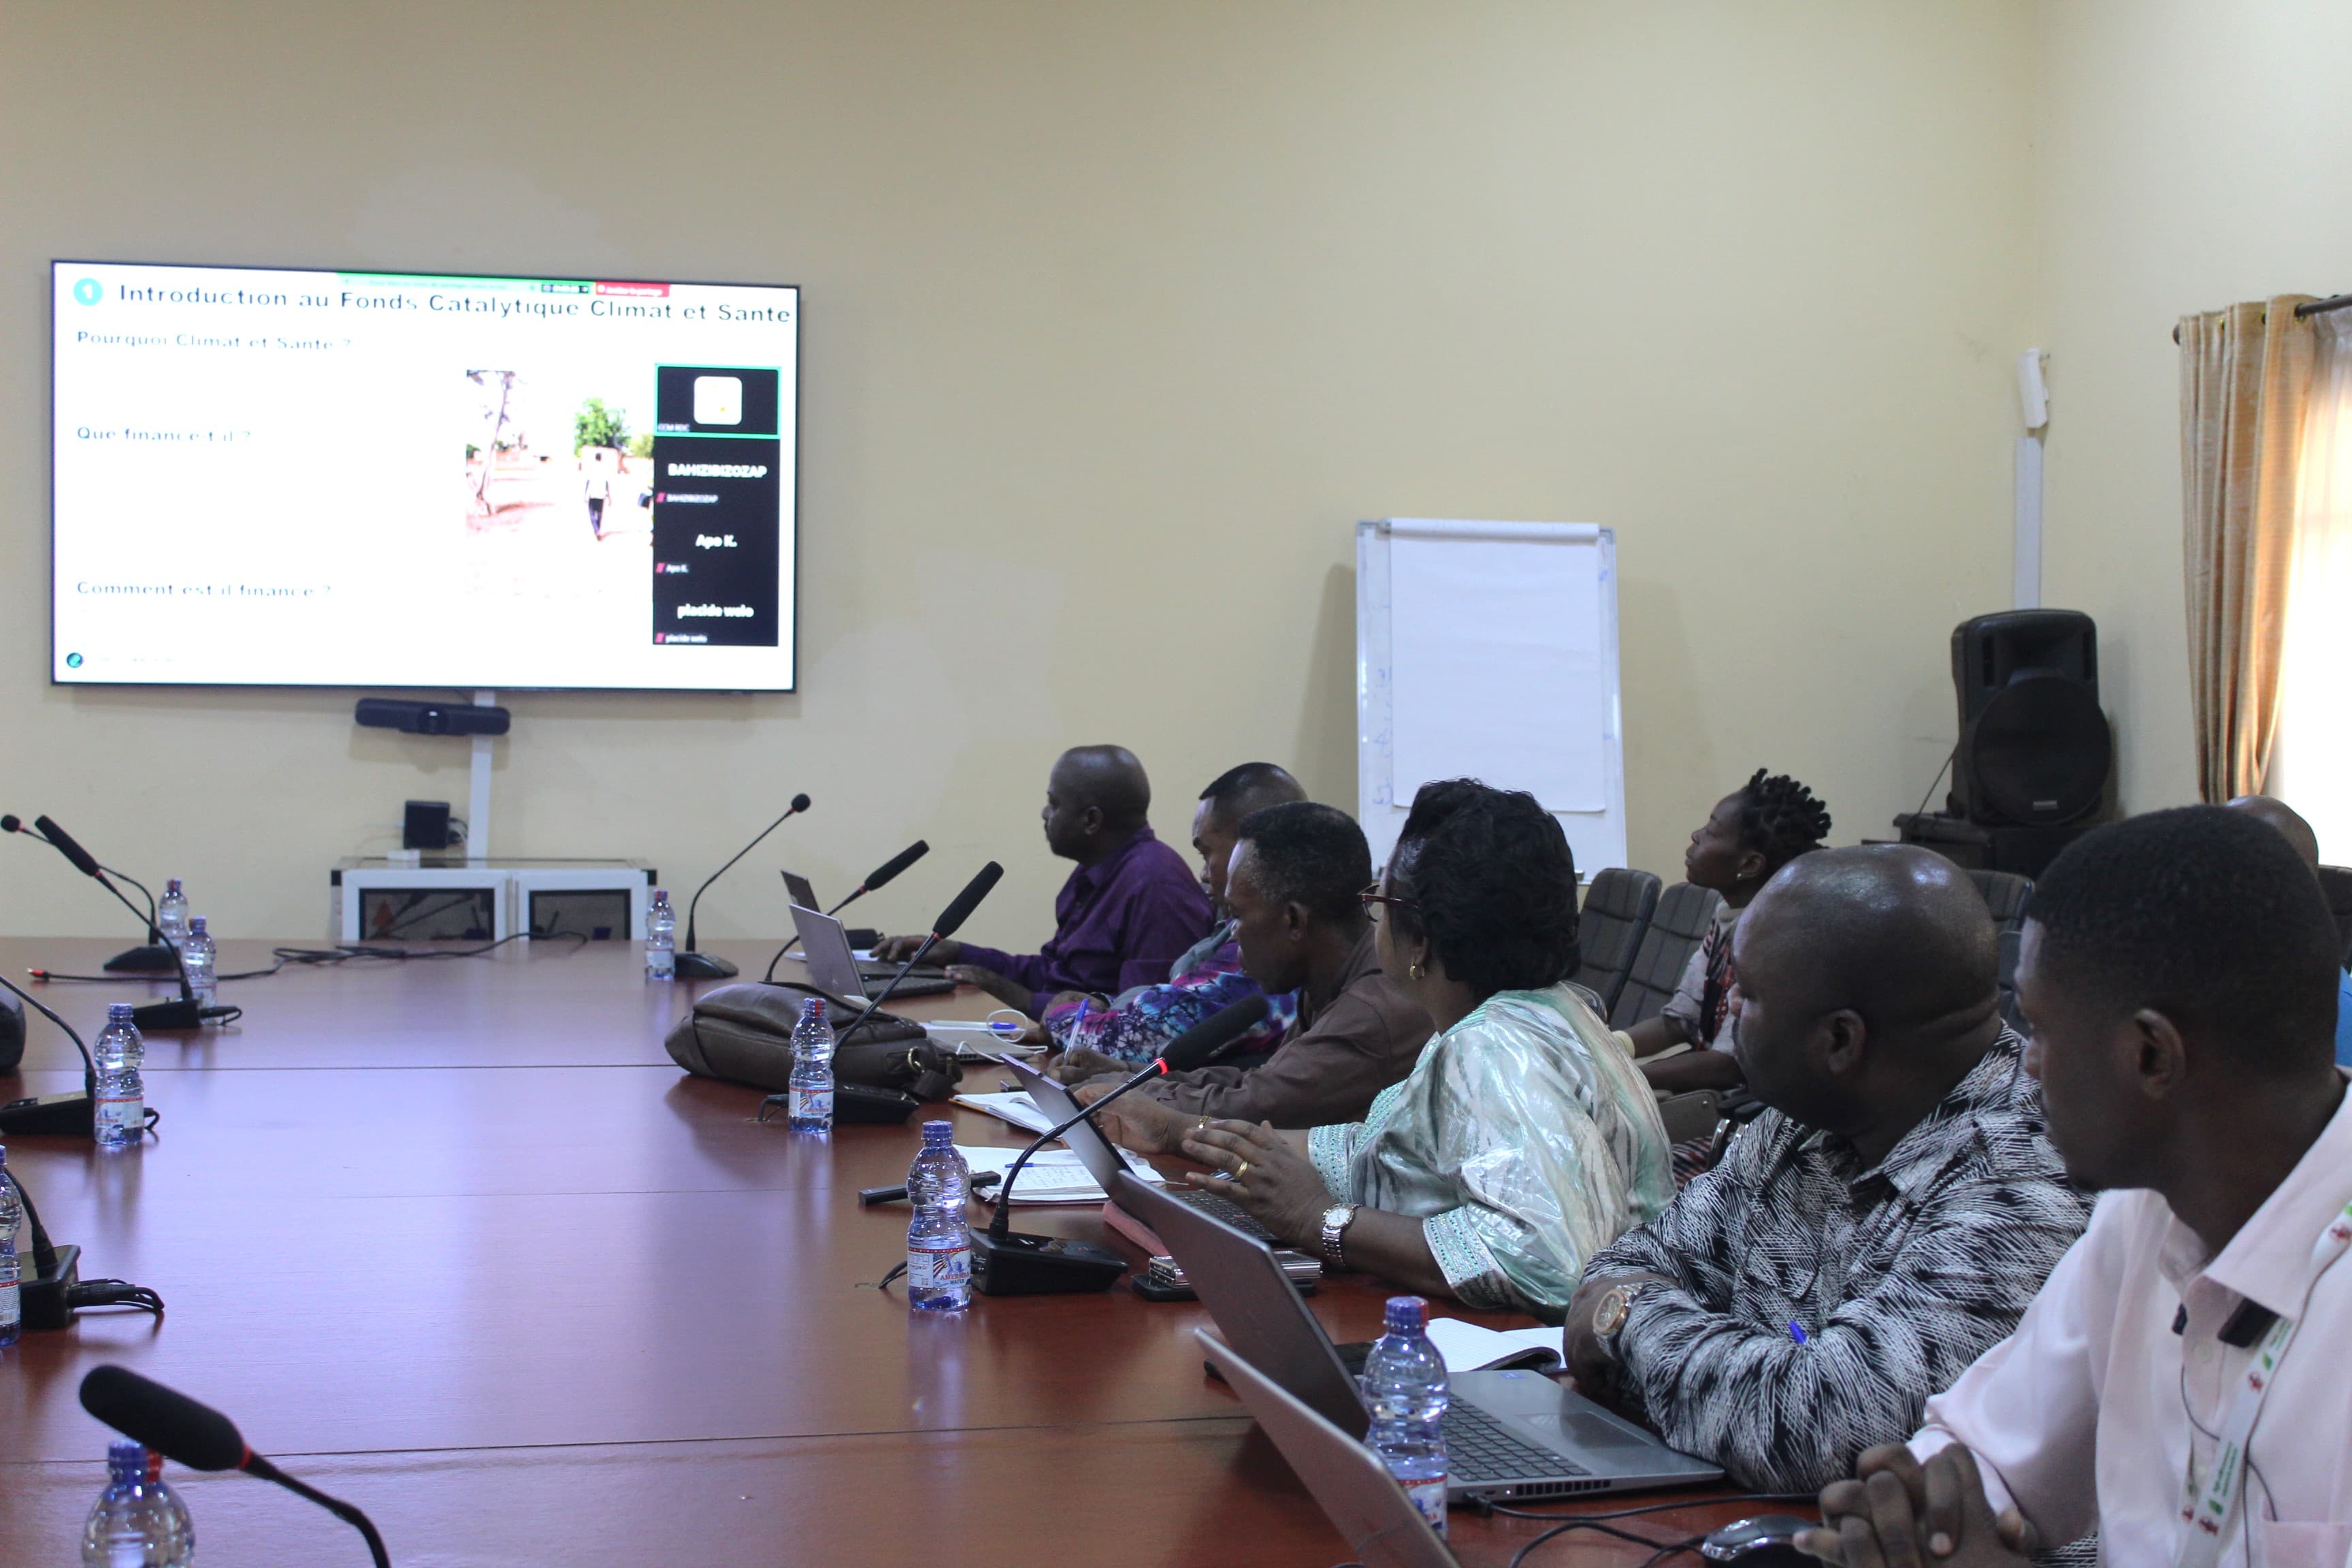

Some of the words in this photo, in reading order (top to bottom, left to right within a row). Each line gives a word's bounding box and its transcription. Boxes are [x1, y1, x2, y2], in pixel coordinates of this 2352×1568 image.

[120, 284, 288, 306] Introduction
[299, 294, 329, 308] au
[341, 291, 418, 310] Fonds
[429, 294, 579, 318] Catalytique
[591, 299, 671, 319] Climat
[683, 305, 706, 320] et
[76, 330, 167, 348] Pourquoi
[176, 333, 240, 348] Climat
[249, 337, 267, 349] et
[76, 425, 116, 440] Que
[76, 581, 173, 595] Comment
